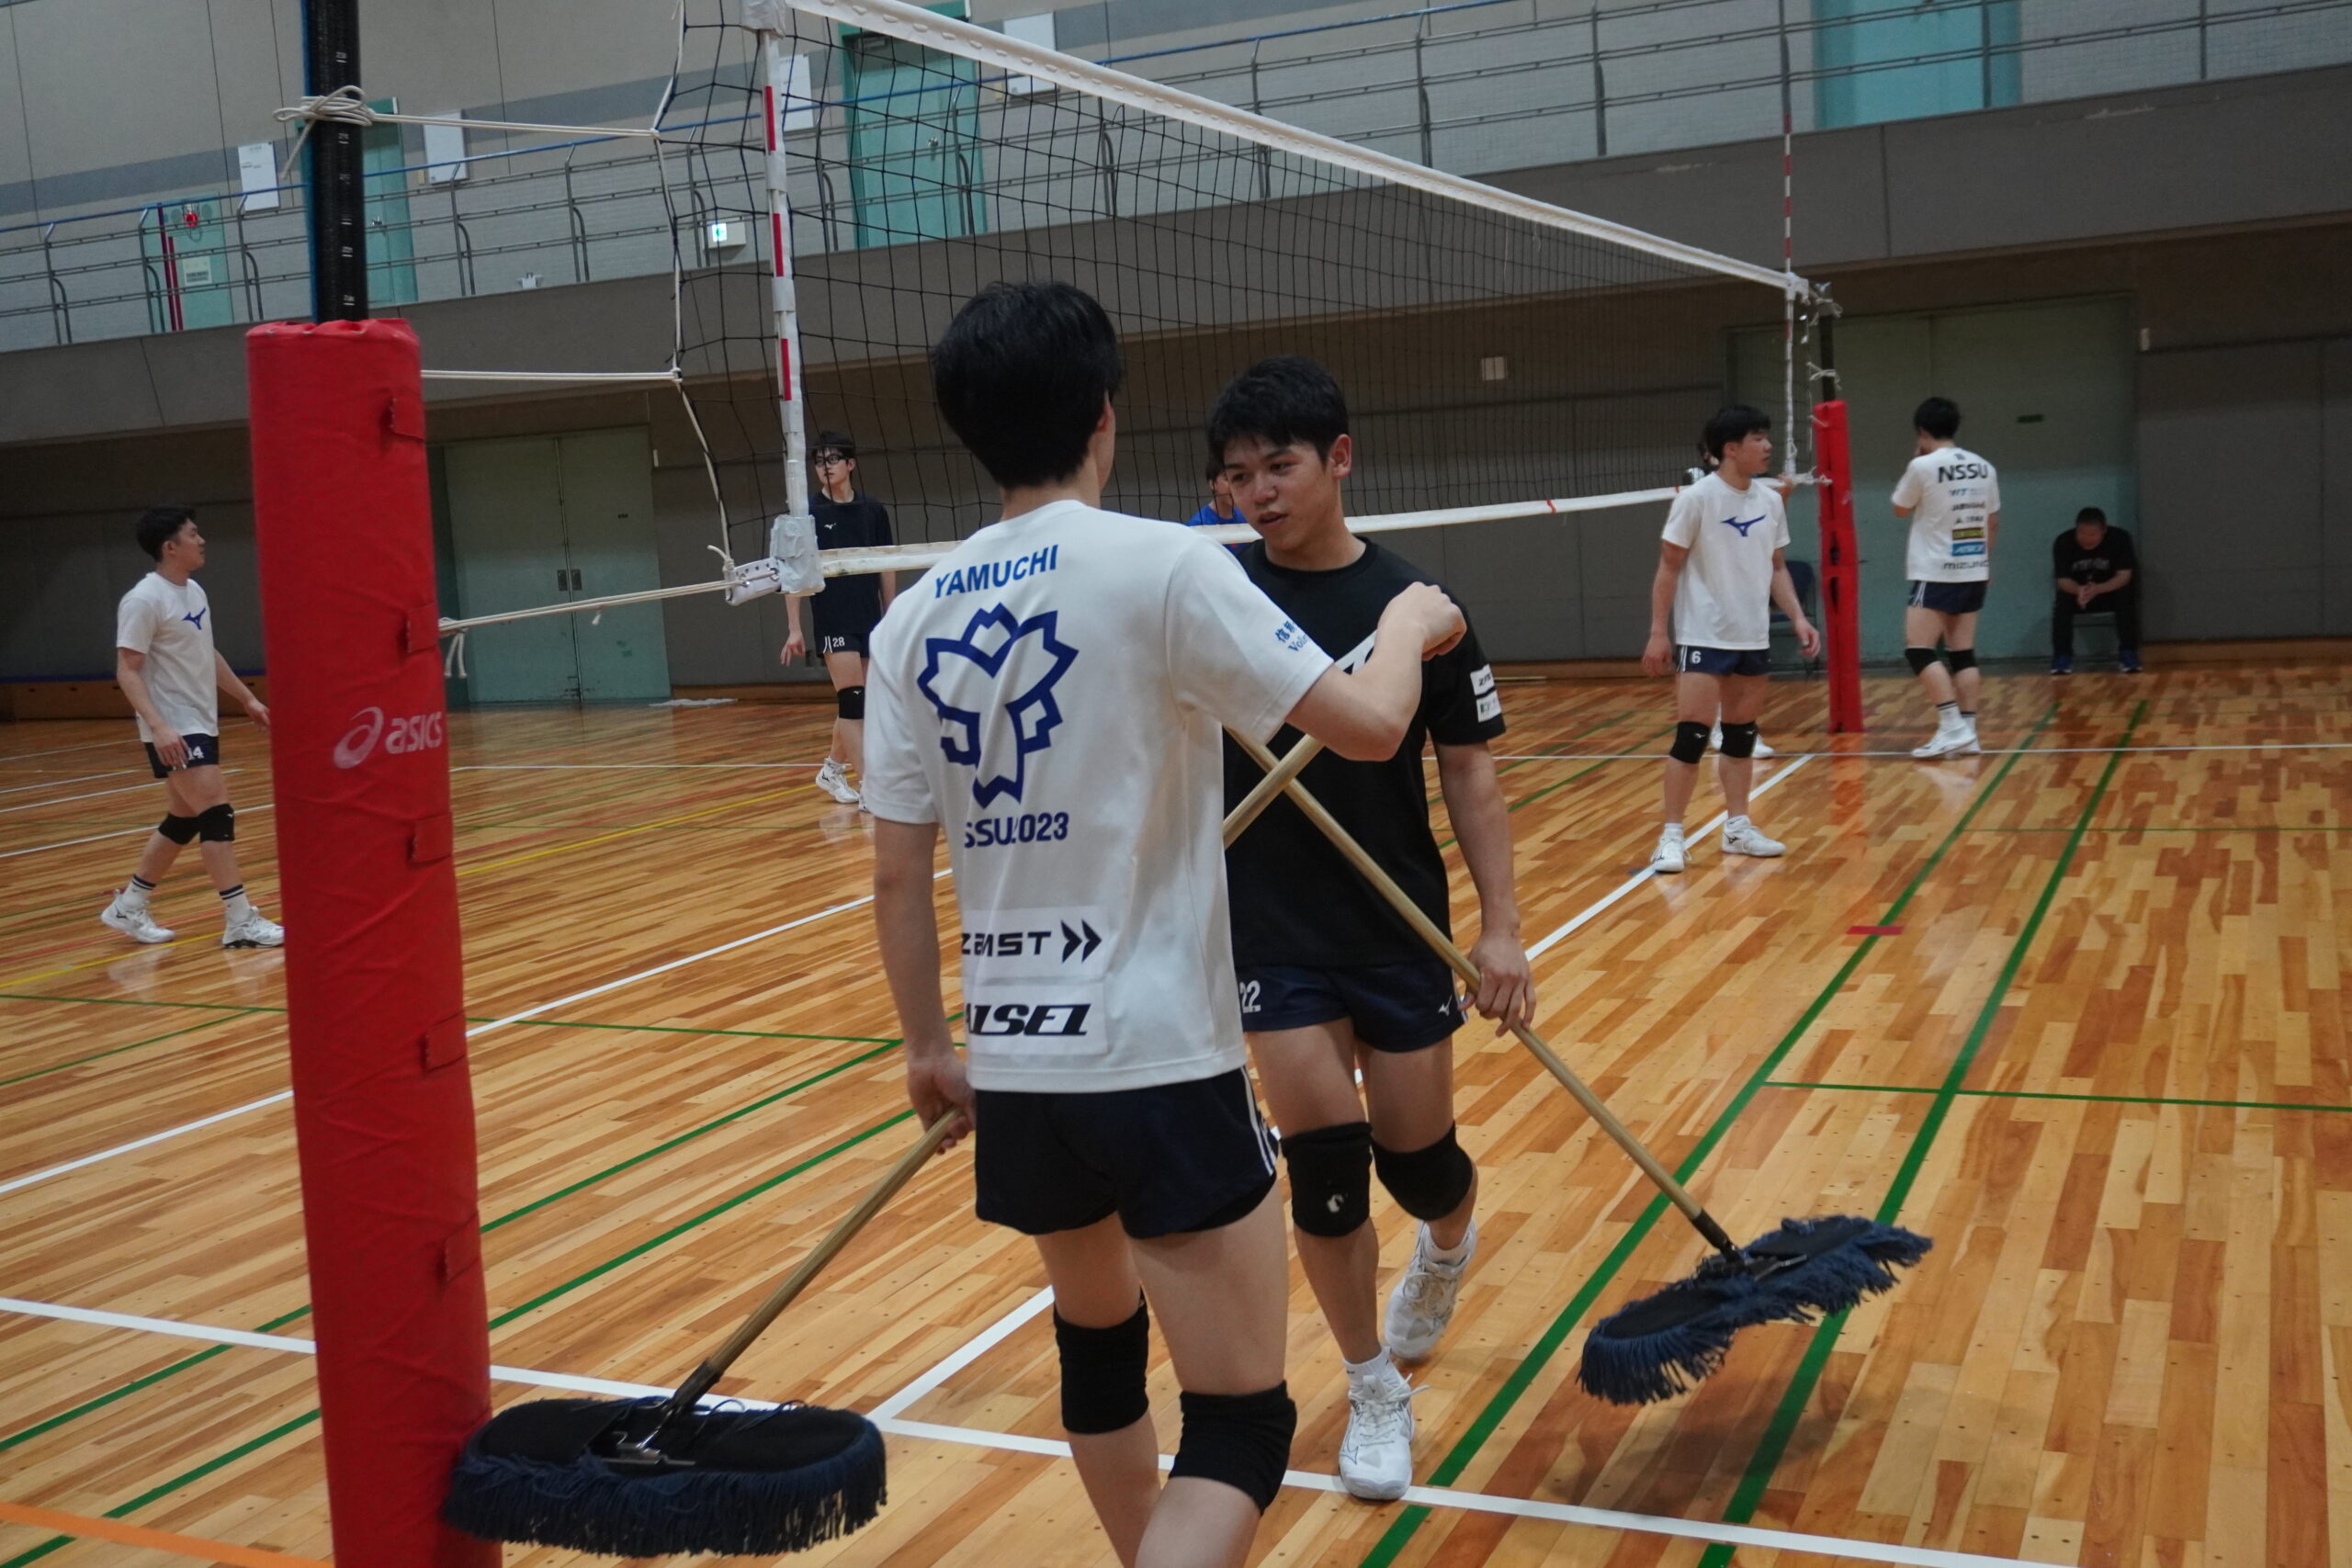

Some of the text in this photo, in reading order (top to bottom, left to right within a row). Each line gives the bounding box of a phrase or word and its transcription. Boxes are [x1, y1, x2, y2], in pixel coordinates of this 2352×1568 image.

[1938, 463, 1988, 483] NSSU
[935, 545, 1058, 599] YAMUCHI
[832, 637, 845, 648] 28
[1691, 650, 1702, 664] 6
[1239, 979, 1261, 1014] 22
